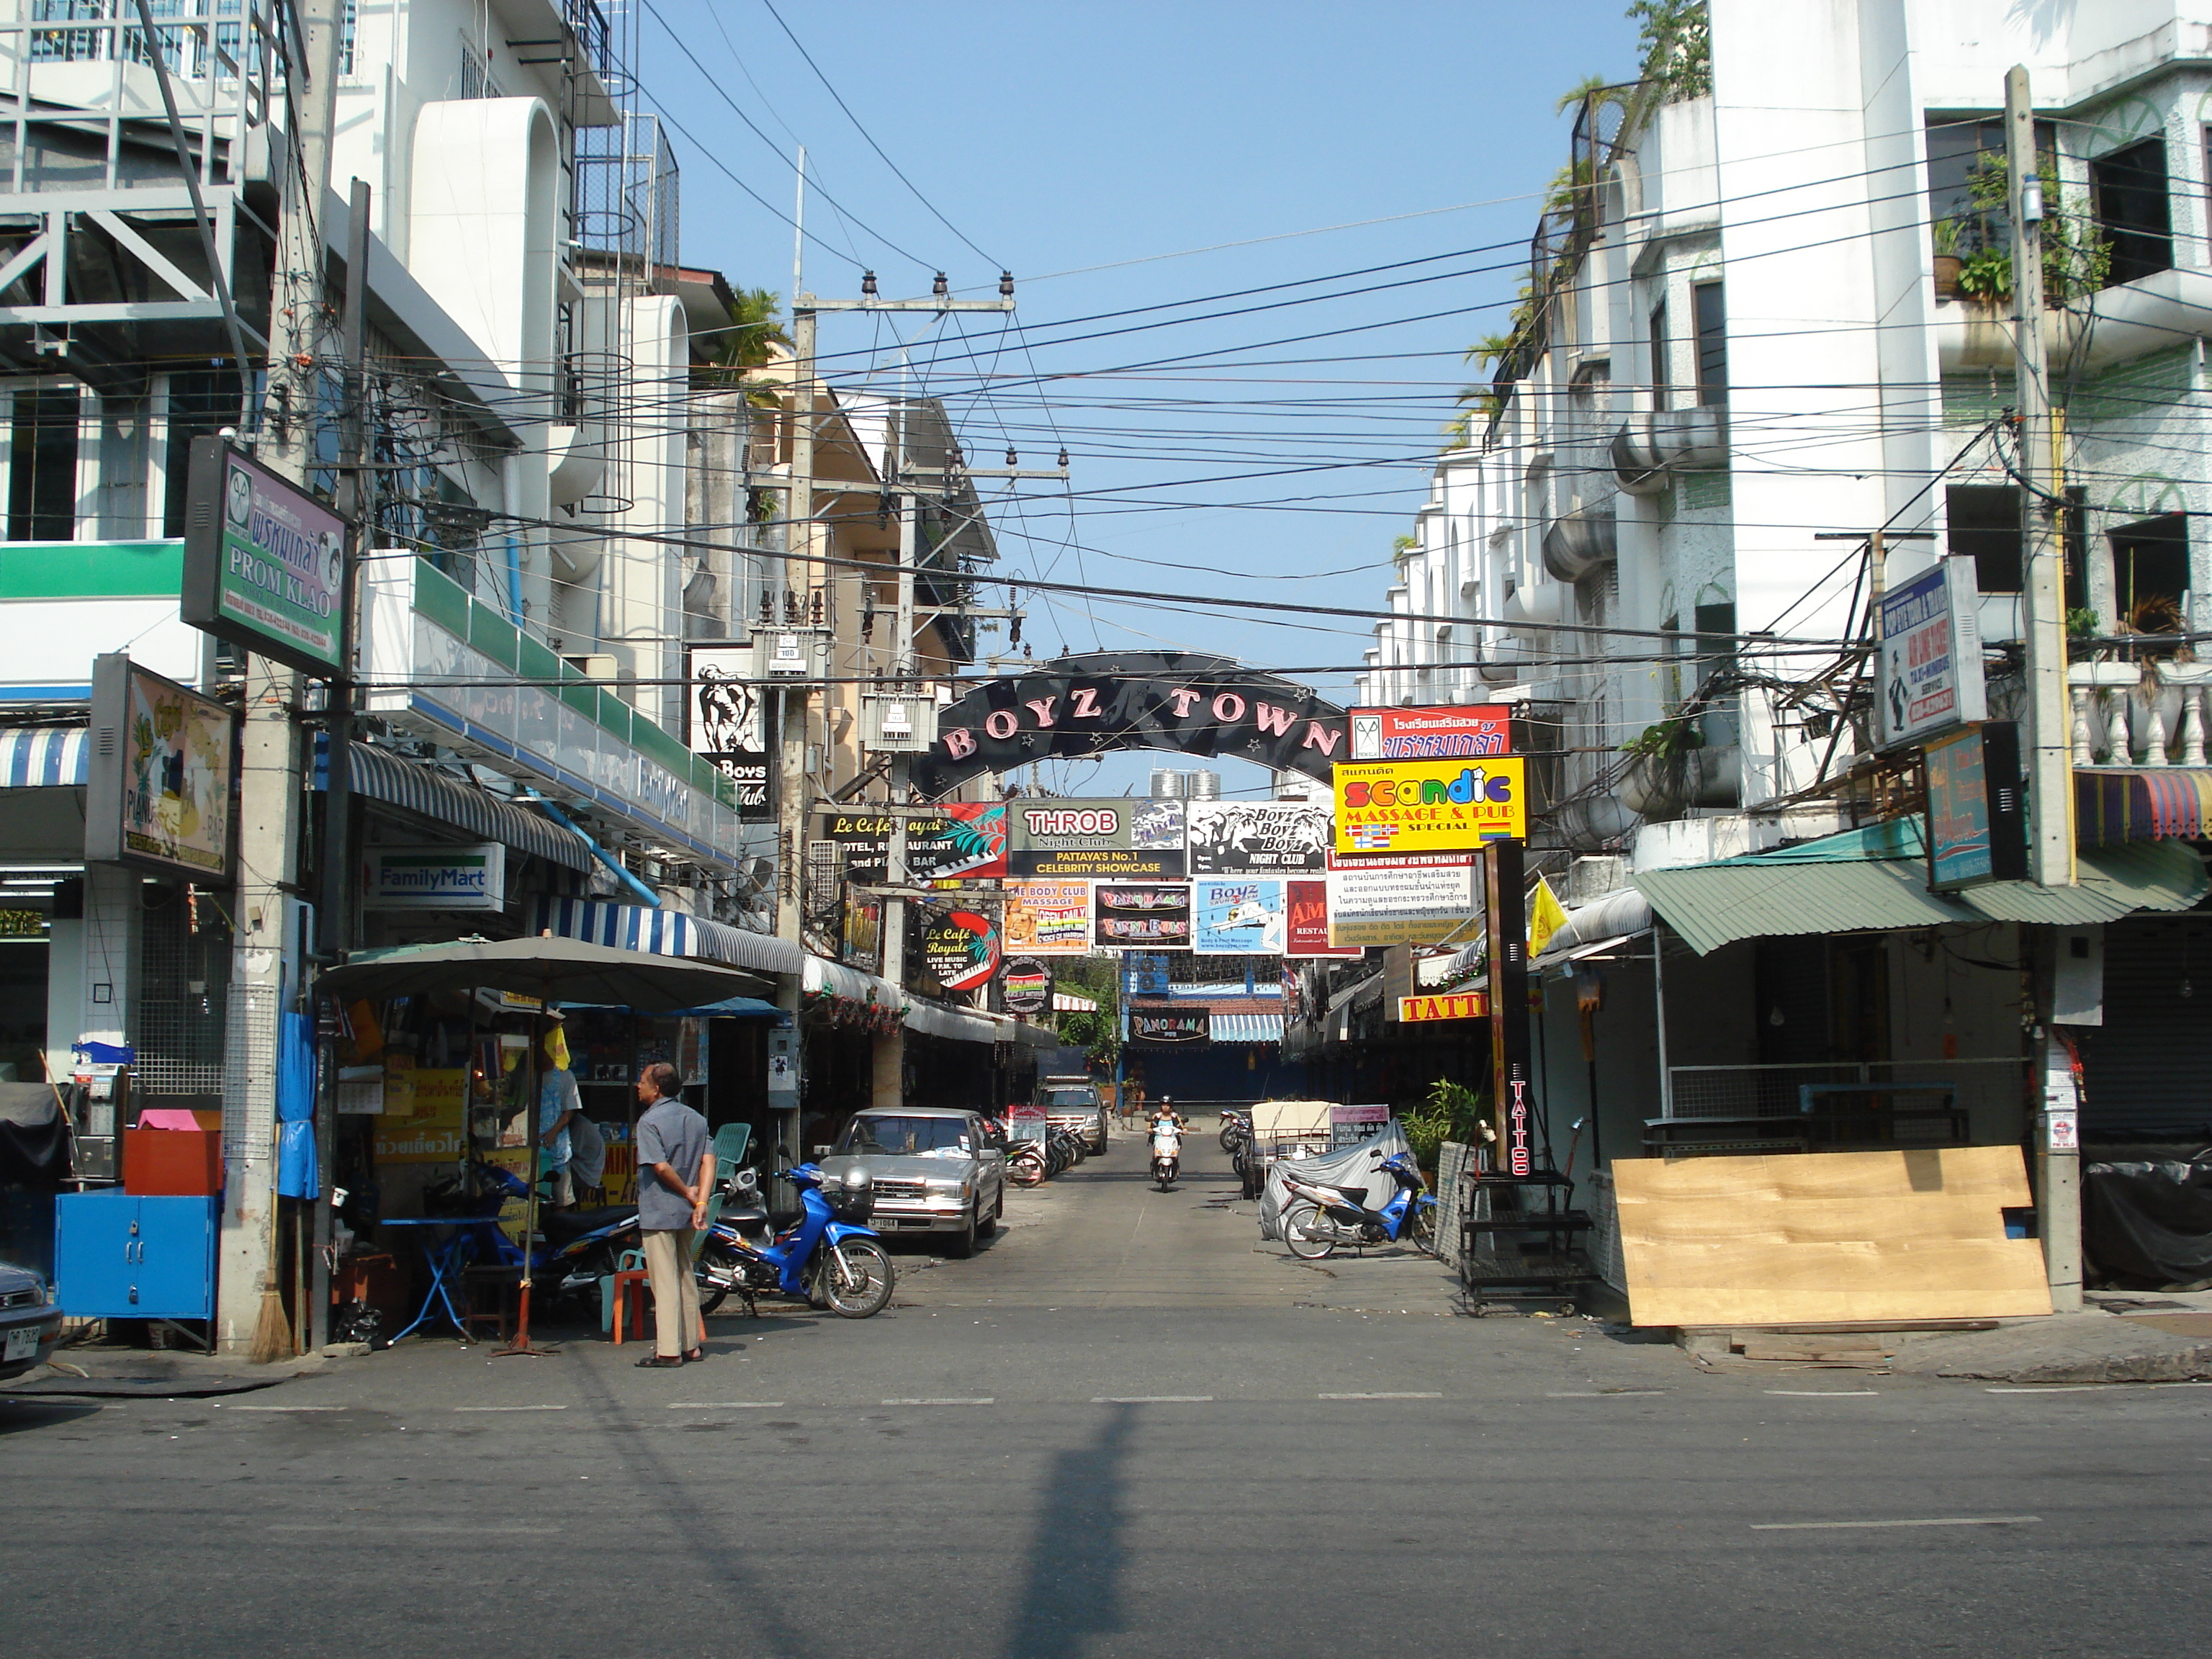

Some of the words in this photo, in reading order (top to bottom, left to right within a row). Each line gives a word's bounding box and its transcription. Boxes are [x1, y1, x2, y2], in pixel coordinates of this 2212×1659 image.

[229, 545, 282, 598] PROM
[285, 571, 332, 619] KLAO
[942, 688, 1102, 762] BOYZ
[1170, 687, 1343, 757] TOWN
[1393, 717, 1479, 730] โรงเรียนเสริมสวย
[1382, 722, 1505, 758] พรหมเกล้า
[720, 760, 766, 779] Boys
[637, 755, 688, 824] FamilyMart
[1344, 766, 1511, 807] scandic
[1026, 812, 1115, 832] THROB
[1254, 809, 1294, 824] Boyz
[1345, 808, 1442, 823] MASSAGE
[1451, 807, 1463, 819] &
[1473, 806, 1514, 819] PUB
[833, 817, 853, 833] Le
[1259, 822, 1299, 837] Boyz
[1408, 822, 1472, 831] SPECIAL
[843, 842, 874, 853] OTEL,
[878, 841, 953, 852] REAURANT
[1039, 837, 1074, 848] Night
[1079, 837, 1111, 847] Club
[1263, 837, 1303, 852] Boyz
[850, 857, 871, 868] and
[913, 856, 936, 866] BAR
[1056, 852, 1108, 861] PATTAYA'S
[1249, 853, 1279, 864] NIGHT
[1282, 853, 1305, 864] CLUB
[1036, 863, 1092, 873] CELEBRITY
[1096, 863, 1161, 873] SHOWCASE
[379, 868, 485, 890] FamilyMart
[1030, 887, 1057, 896] BODY
[1062, 887, 1086, 896] CLUB
[1210, 884, 1259, 900] Boyz
[1103, 893, 1185, 907] PANORAMA
[1210, 897, 1233, 906] SAUNA
[1038, 909, 1061, 922] OPEN
[1063, 907, 1086, 920] DAILY
[1289, 902, 1326, 930] AM
[1103, 919, 1147, 935] FUNNY
[1149, 919, 1186, 935] BOYS
[926, 928, 941, 940] Le
[943, 927, 971, 943] Café
[927, 942, 969, 956] Royale
[1133, 1016, 1205, 1035] PANORAMA
[1511, 1080, 1529, 1177] TATTOO
